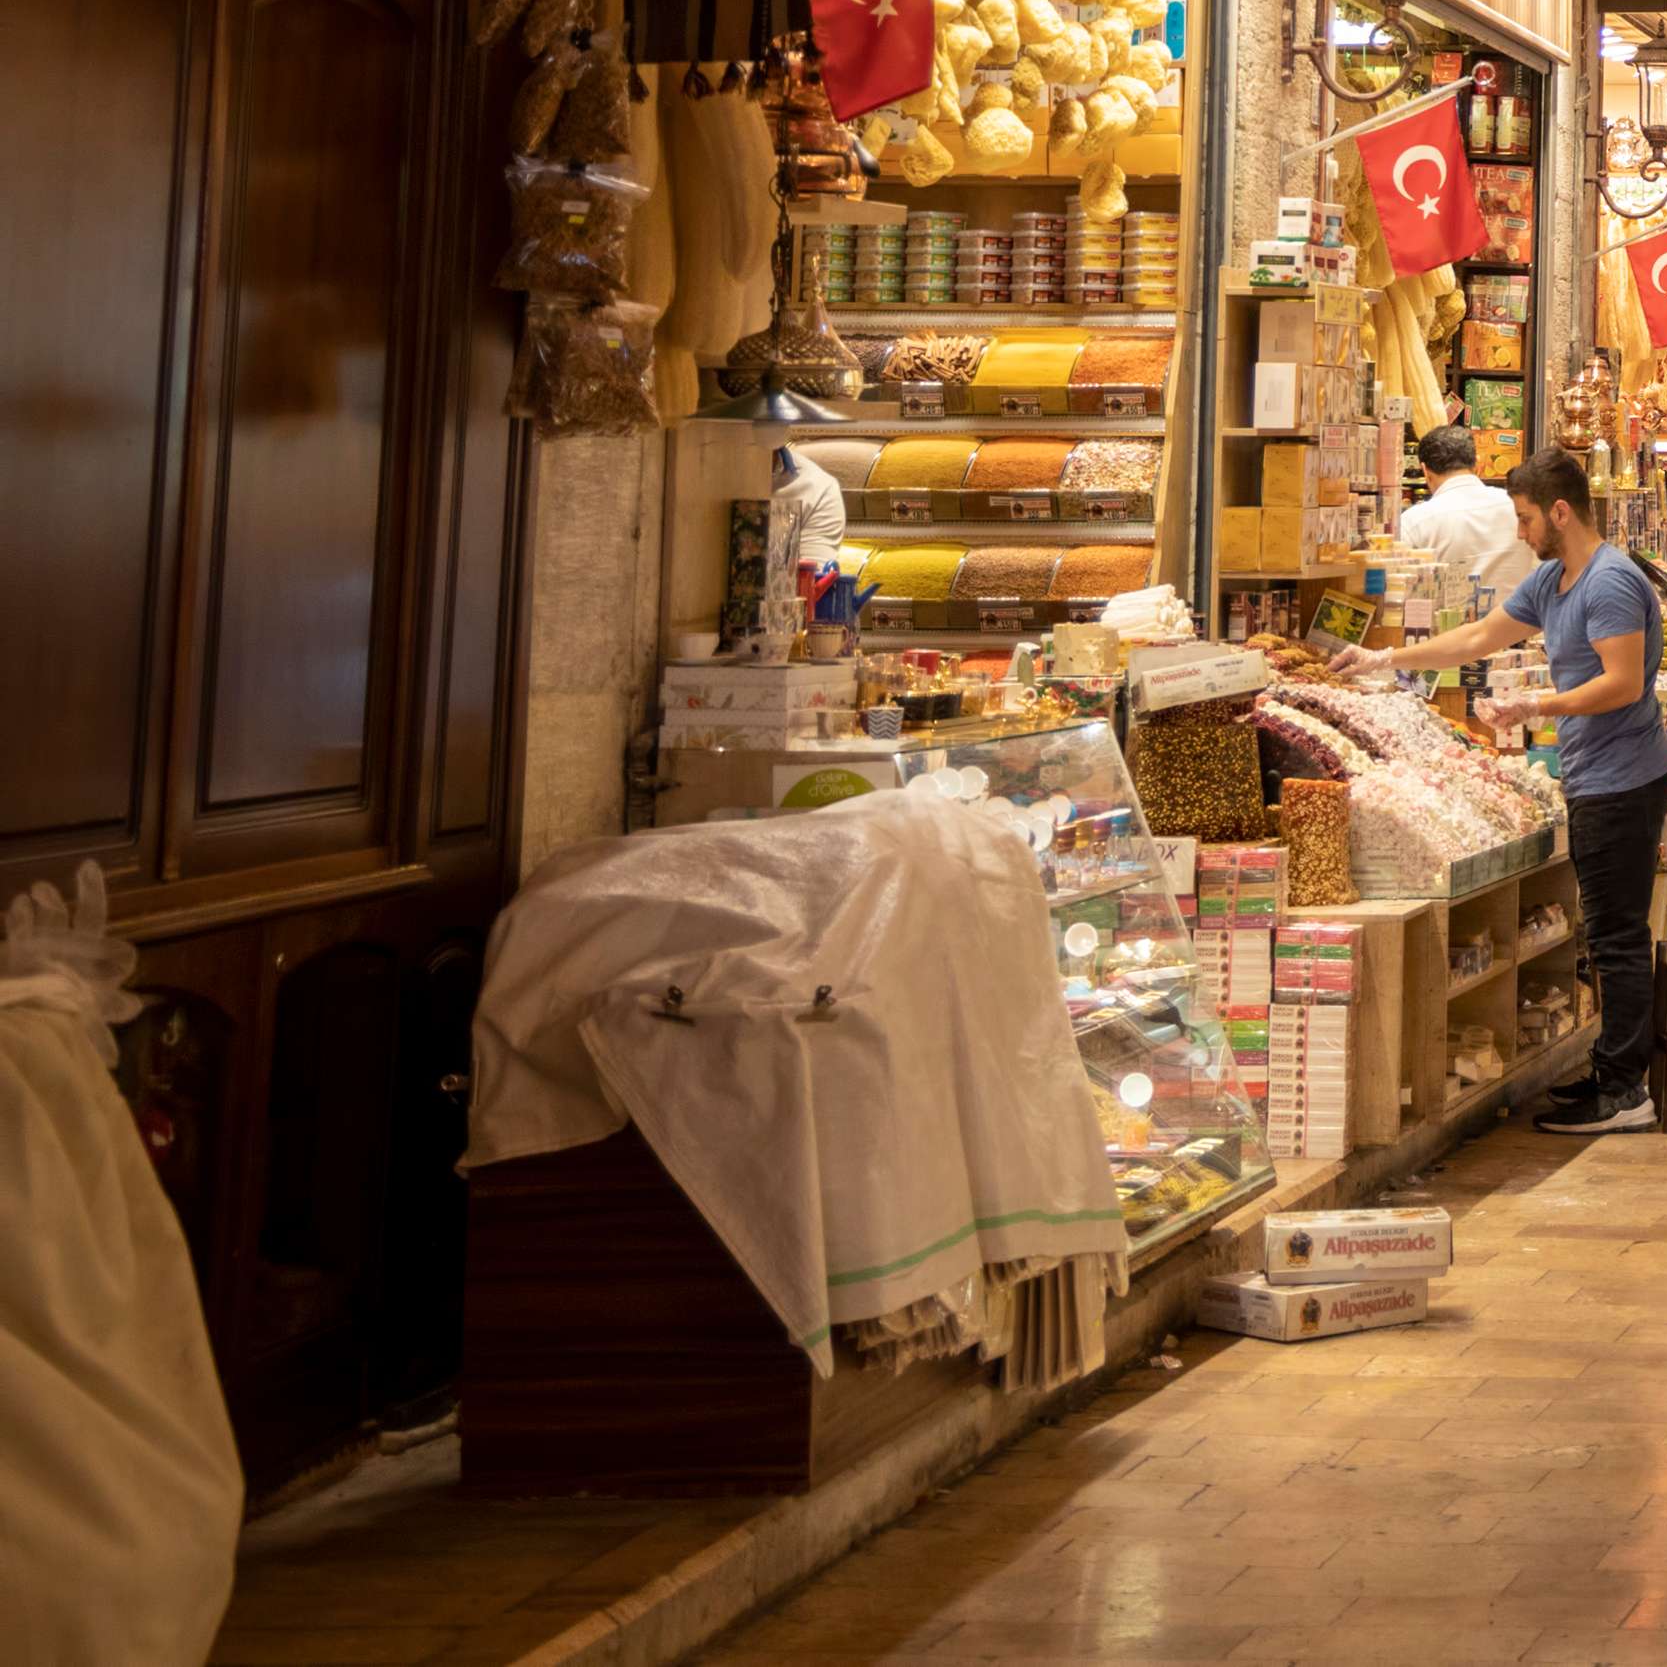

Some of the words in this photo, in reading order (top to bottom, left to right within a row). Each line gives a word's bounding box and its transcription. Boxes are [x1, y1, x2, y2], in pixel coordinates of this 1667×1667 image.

[1473, 167, 1505, 181] TEA
[1477, 383, 1500, 398] TEA
[1323, 1232, 1437, 1260] Alipaşazade
[1329, 1289, 1416, 1323] Alipaşazade
